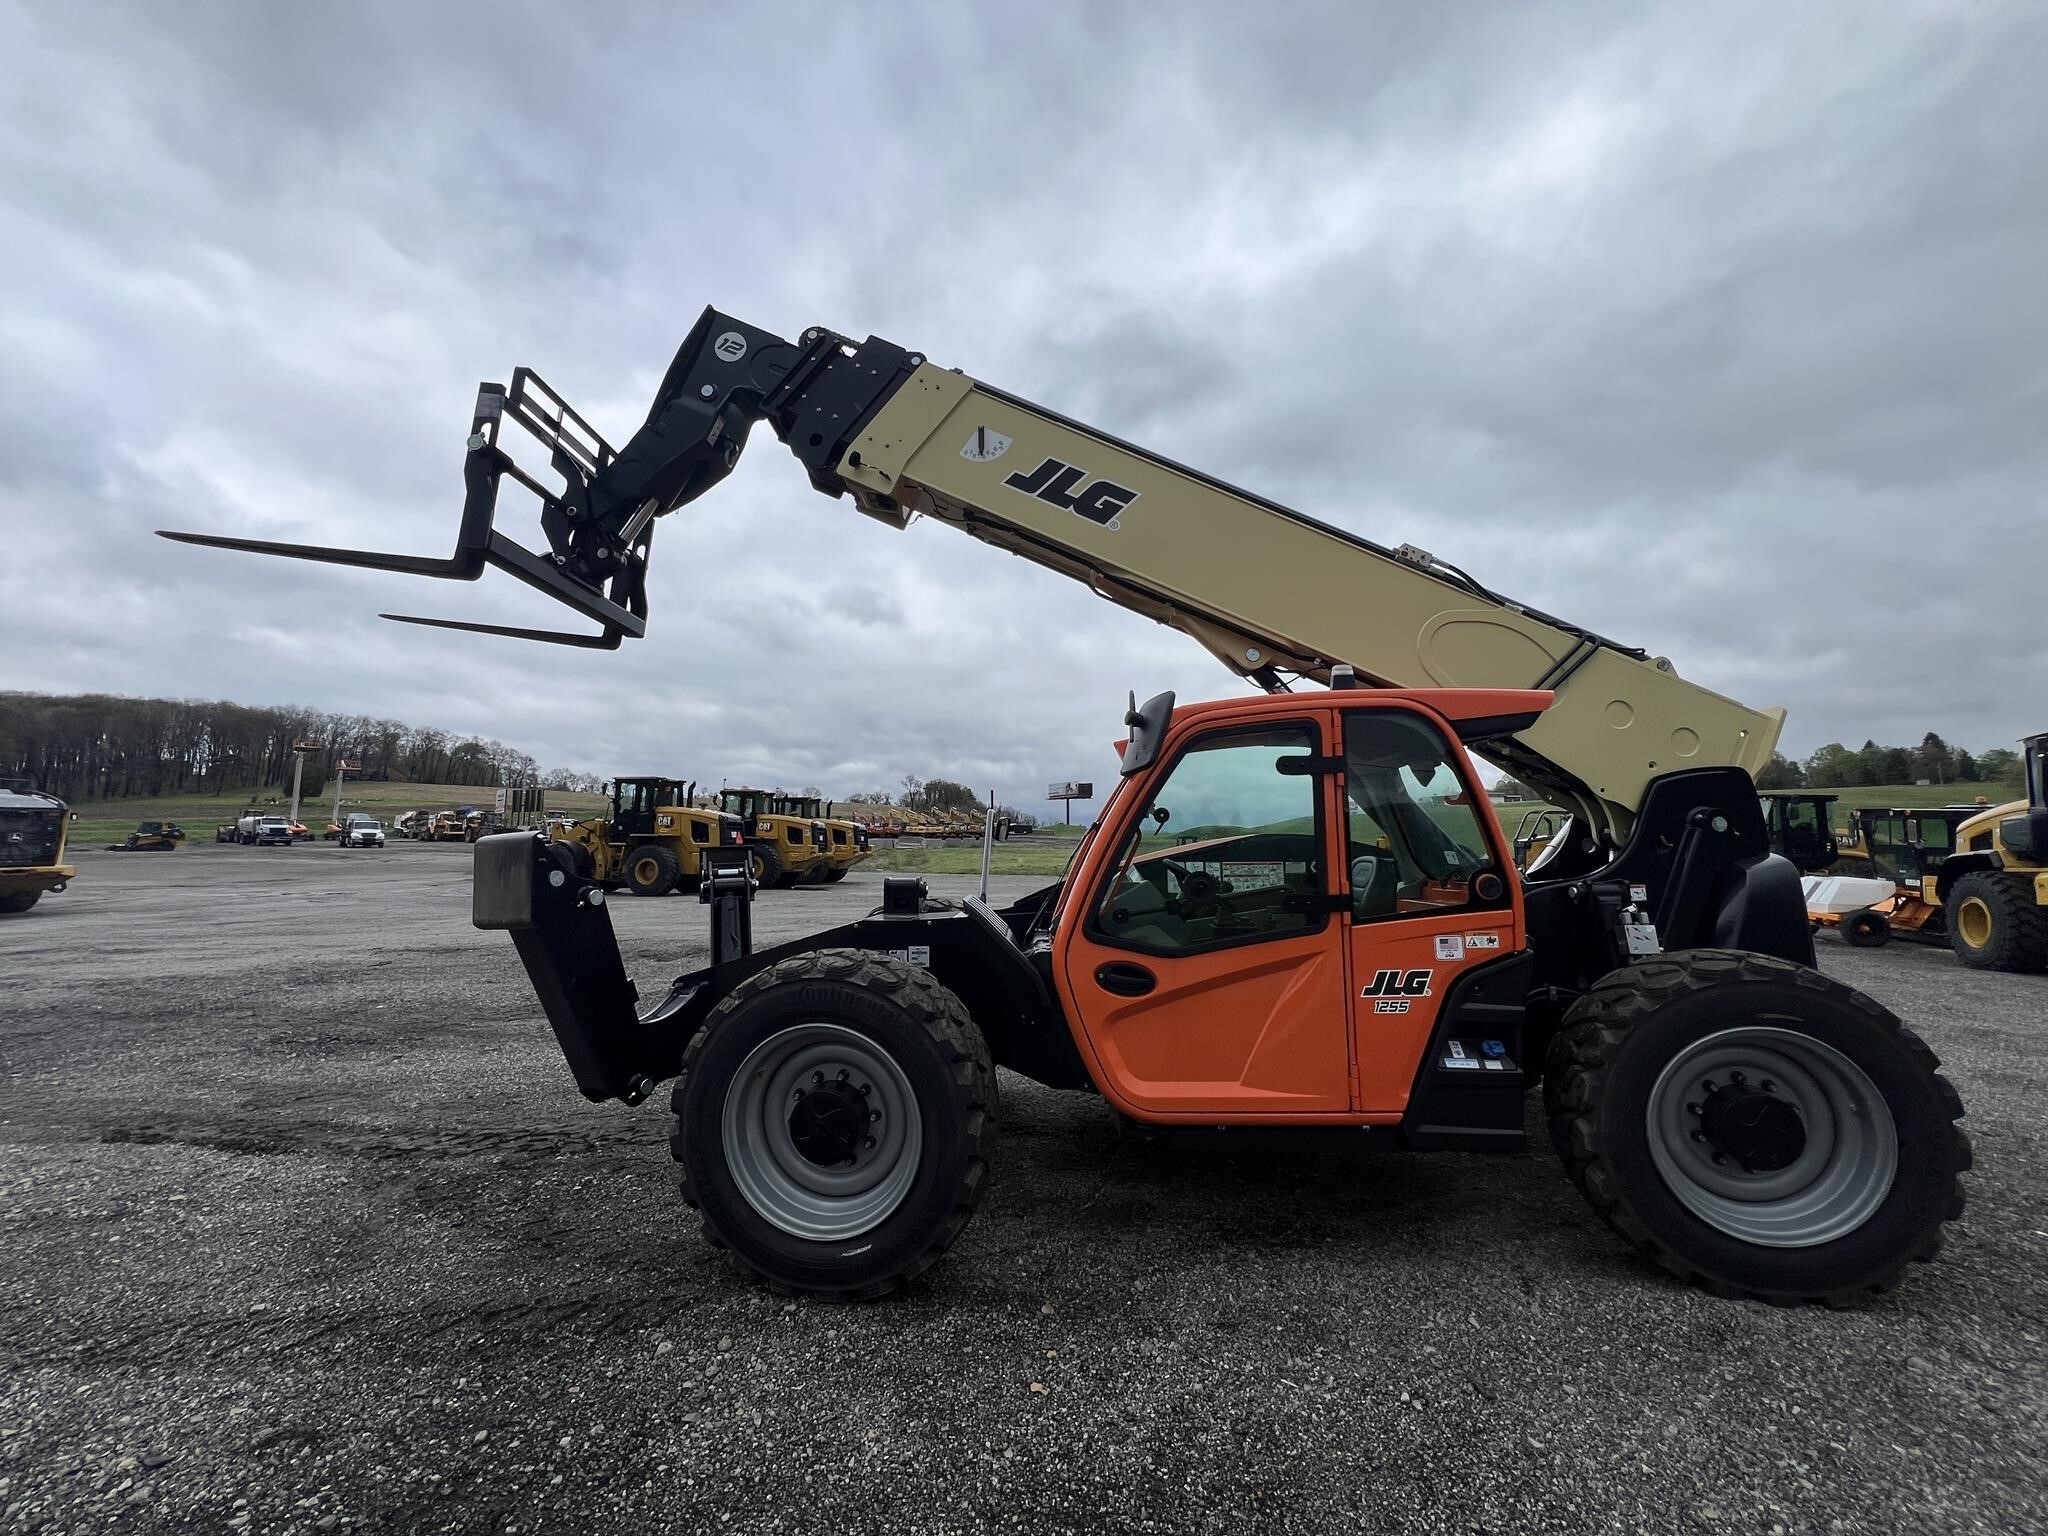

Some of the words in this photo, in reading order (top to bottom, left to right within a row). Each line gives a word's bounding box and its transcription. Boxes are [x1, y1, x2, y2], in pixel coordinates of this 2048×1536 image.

[717, 337, 745, 356] 12
[1003, 457, 1139, 526] JLG
[657, 816, 672, 826] CAT
[758, 822, 772, 831] CAT
[1362, 970, 1432, 997] JLG
[1375, 1001, 1410, 1014] 1255
